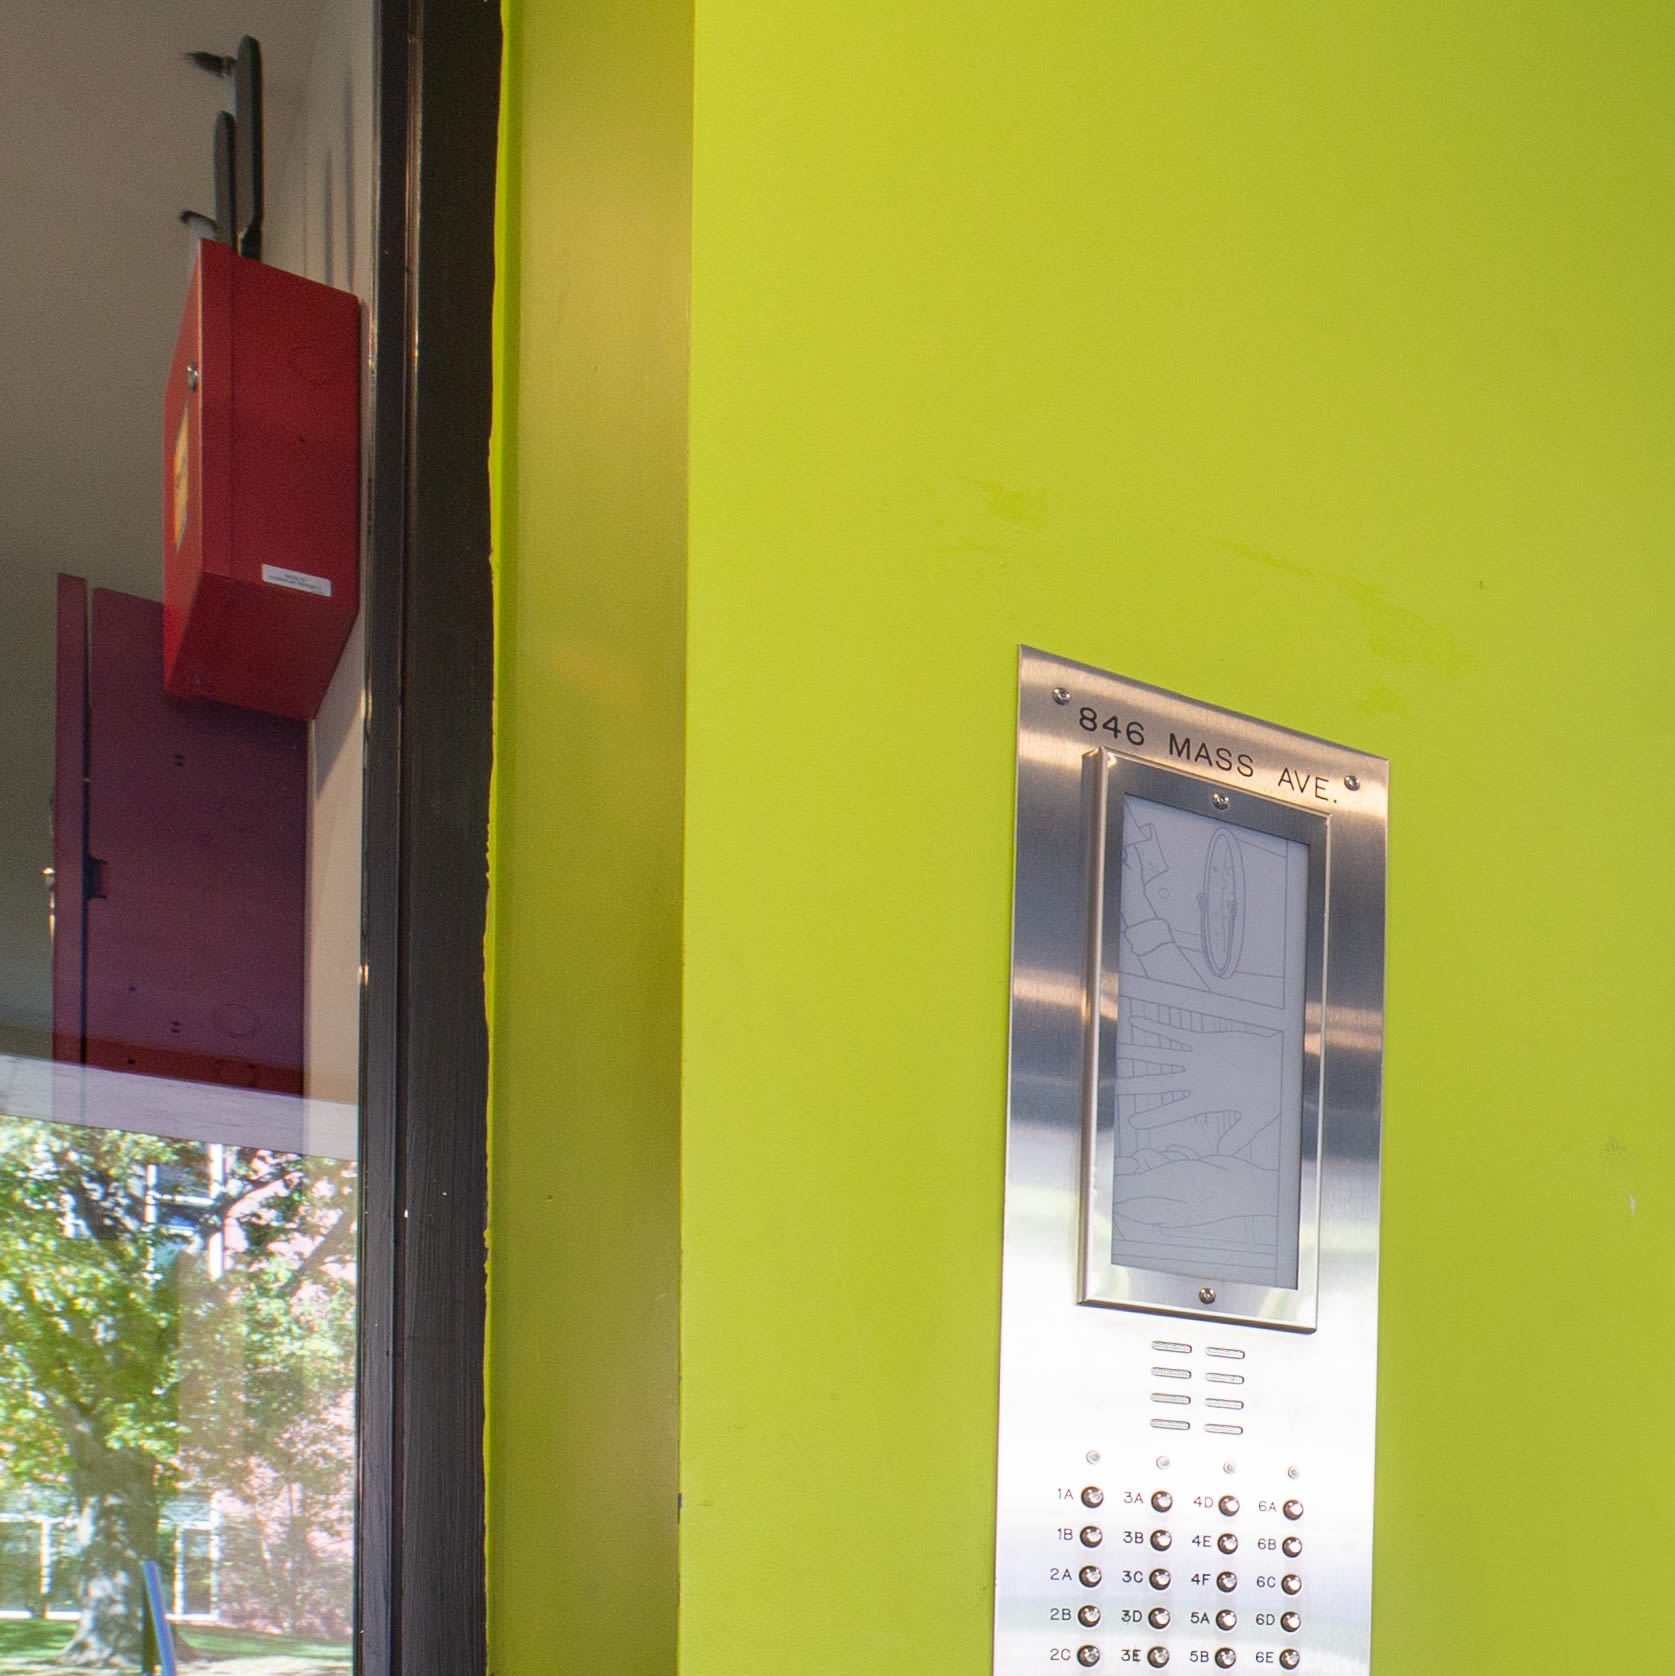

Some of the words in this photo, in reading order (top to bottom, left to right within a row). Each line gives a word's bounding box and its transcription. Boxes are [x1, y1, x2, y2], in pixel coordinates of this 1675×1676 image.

[1079, 707, 1145, 746] 846
[1169, 733, 1255, 777] MASS
[1278, 768, 1337, 803] AVE.
[1056, 1487, 1074, 1500] 1A
[1123, 1491, 1144, 1505] 3A
[1193, 1496, 1214, 1509] 4D
[1258, 1500, 1277, 1513] 6A
[1056, 1528, 1073, 1541] 1B
[1123, 1531, 1144, 1545] 3B
[1191, 1535, 1212, 1548] 4E
[1257, 1538, 1277, 1551] 6B
[1050, 1568, 1073, 1582] 2A
[1121, 1570, 1144, 1584] 3C
[1190, 1573, 1211, 1587] 4F
[1256, 1575, 1276, 1589] 6C
[1049, 1607, 1072, 1622] 2B
[1121, 1609, 1143, 1623] 3D
[1189, 1612, 1210, 1625] 5A
[1255, 1613, 1276, 1626] 6D
[1049, 1648, 1071, 1662] 2C
[1121, 1649, 1142, 1663] 3E
[1189, 1650, 1210, 1663] 5B
[1255, 1651, 1274, 1664] 6E
